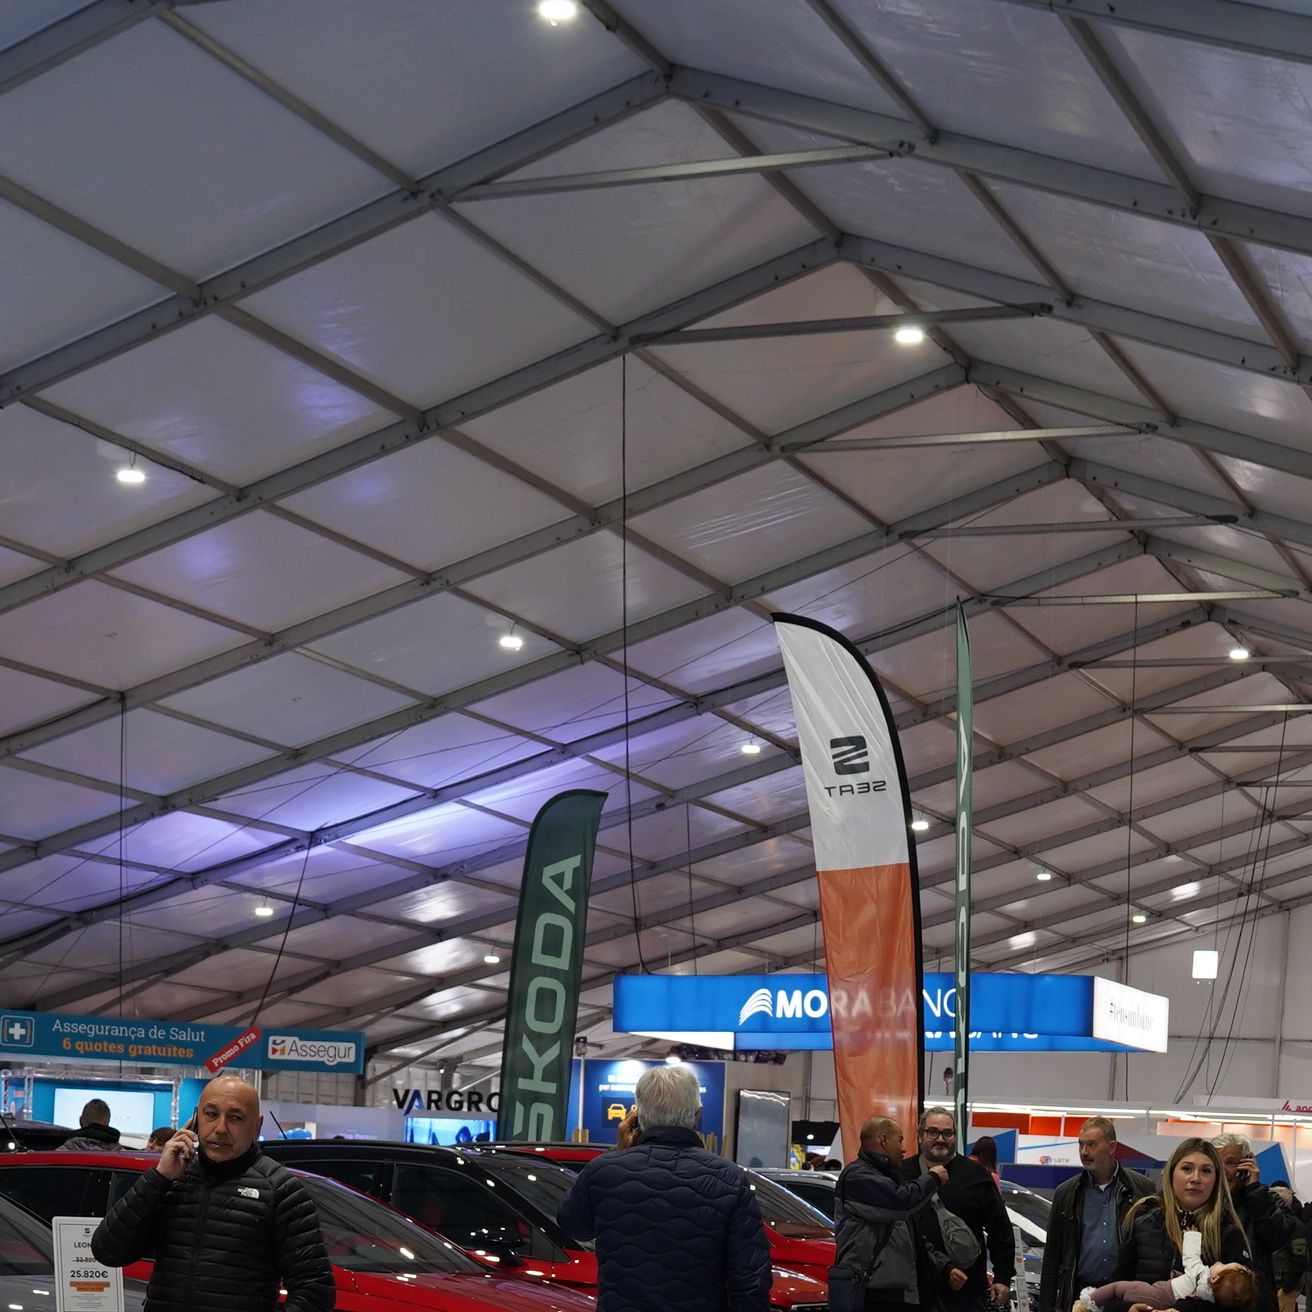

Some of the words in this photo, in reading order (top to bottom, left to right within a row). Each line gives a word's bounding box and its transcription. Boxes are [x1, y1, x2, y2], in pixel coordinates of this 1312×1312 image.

[52, 1019, 145, 1040] Assegurança
[148, 1025, 166, 1039] de
[169, 1027, 206, 1042] Salut
[63, 1037, 72, 1050] 6
[75, 1039, 125, 1055] quotes
[212, 1045, 240, 1067] Promo
[237, 1032, 257, 1047] Fira
[287, 1040, 353, 1062] Assegur
[70, 1270, 108, 1279] 25.820€
